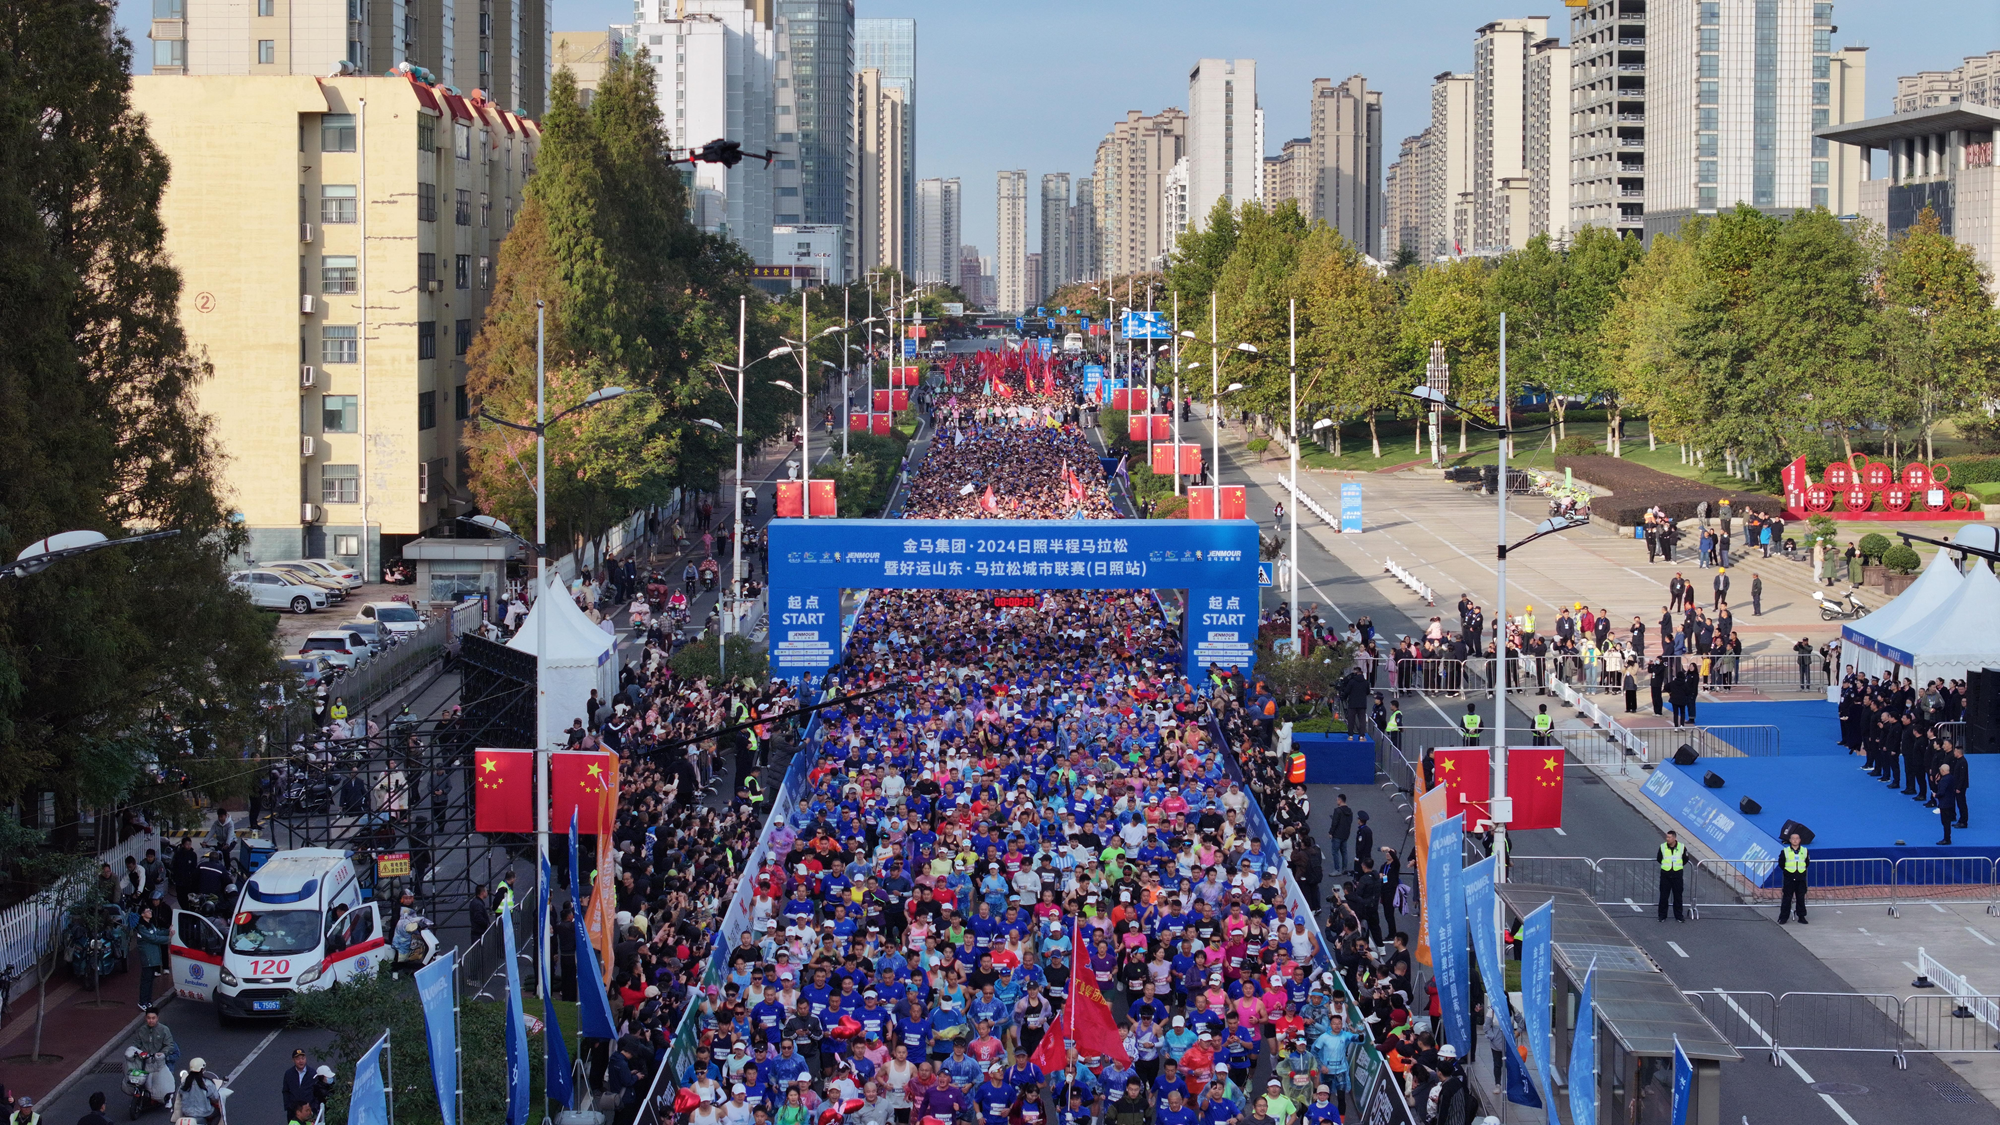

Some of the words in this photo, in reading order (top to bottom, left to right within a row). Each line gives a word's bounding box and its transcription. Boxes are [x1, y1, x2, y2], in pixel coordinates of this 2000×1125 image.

[200, 295, 210, 310] 2
[903, 538, 1128, 554] 金马集团·2024日照半程马拉松
[884, 560, 1147, 577] 暨好运山东·马拉松城市联赛(日照站)
[788, 595, 819, 610] 起点
[994, 597, 1034, 607] 00:00:23
[1208, 596, 1240, 610] 起点
[782, 613, 825, 625] START
[1202, 613, 1246, 625] START
[237, 914, 247, 924] 1
[250, 959, 290, 975] 120
[184, 979, 208, 988] Ambulance
